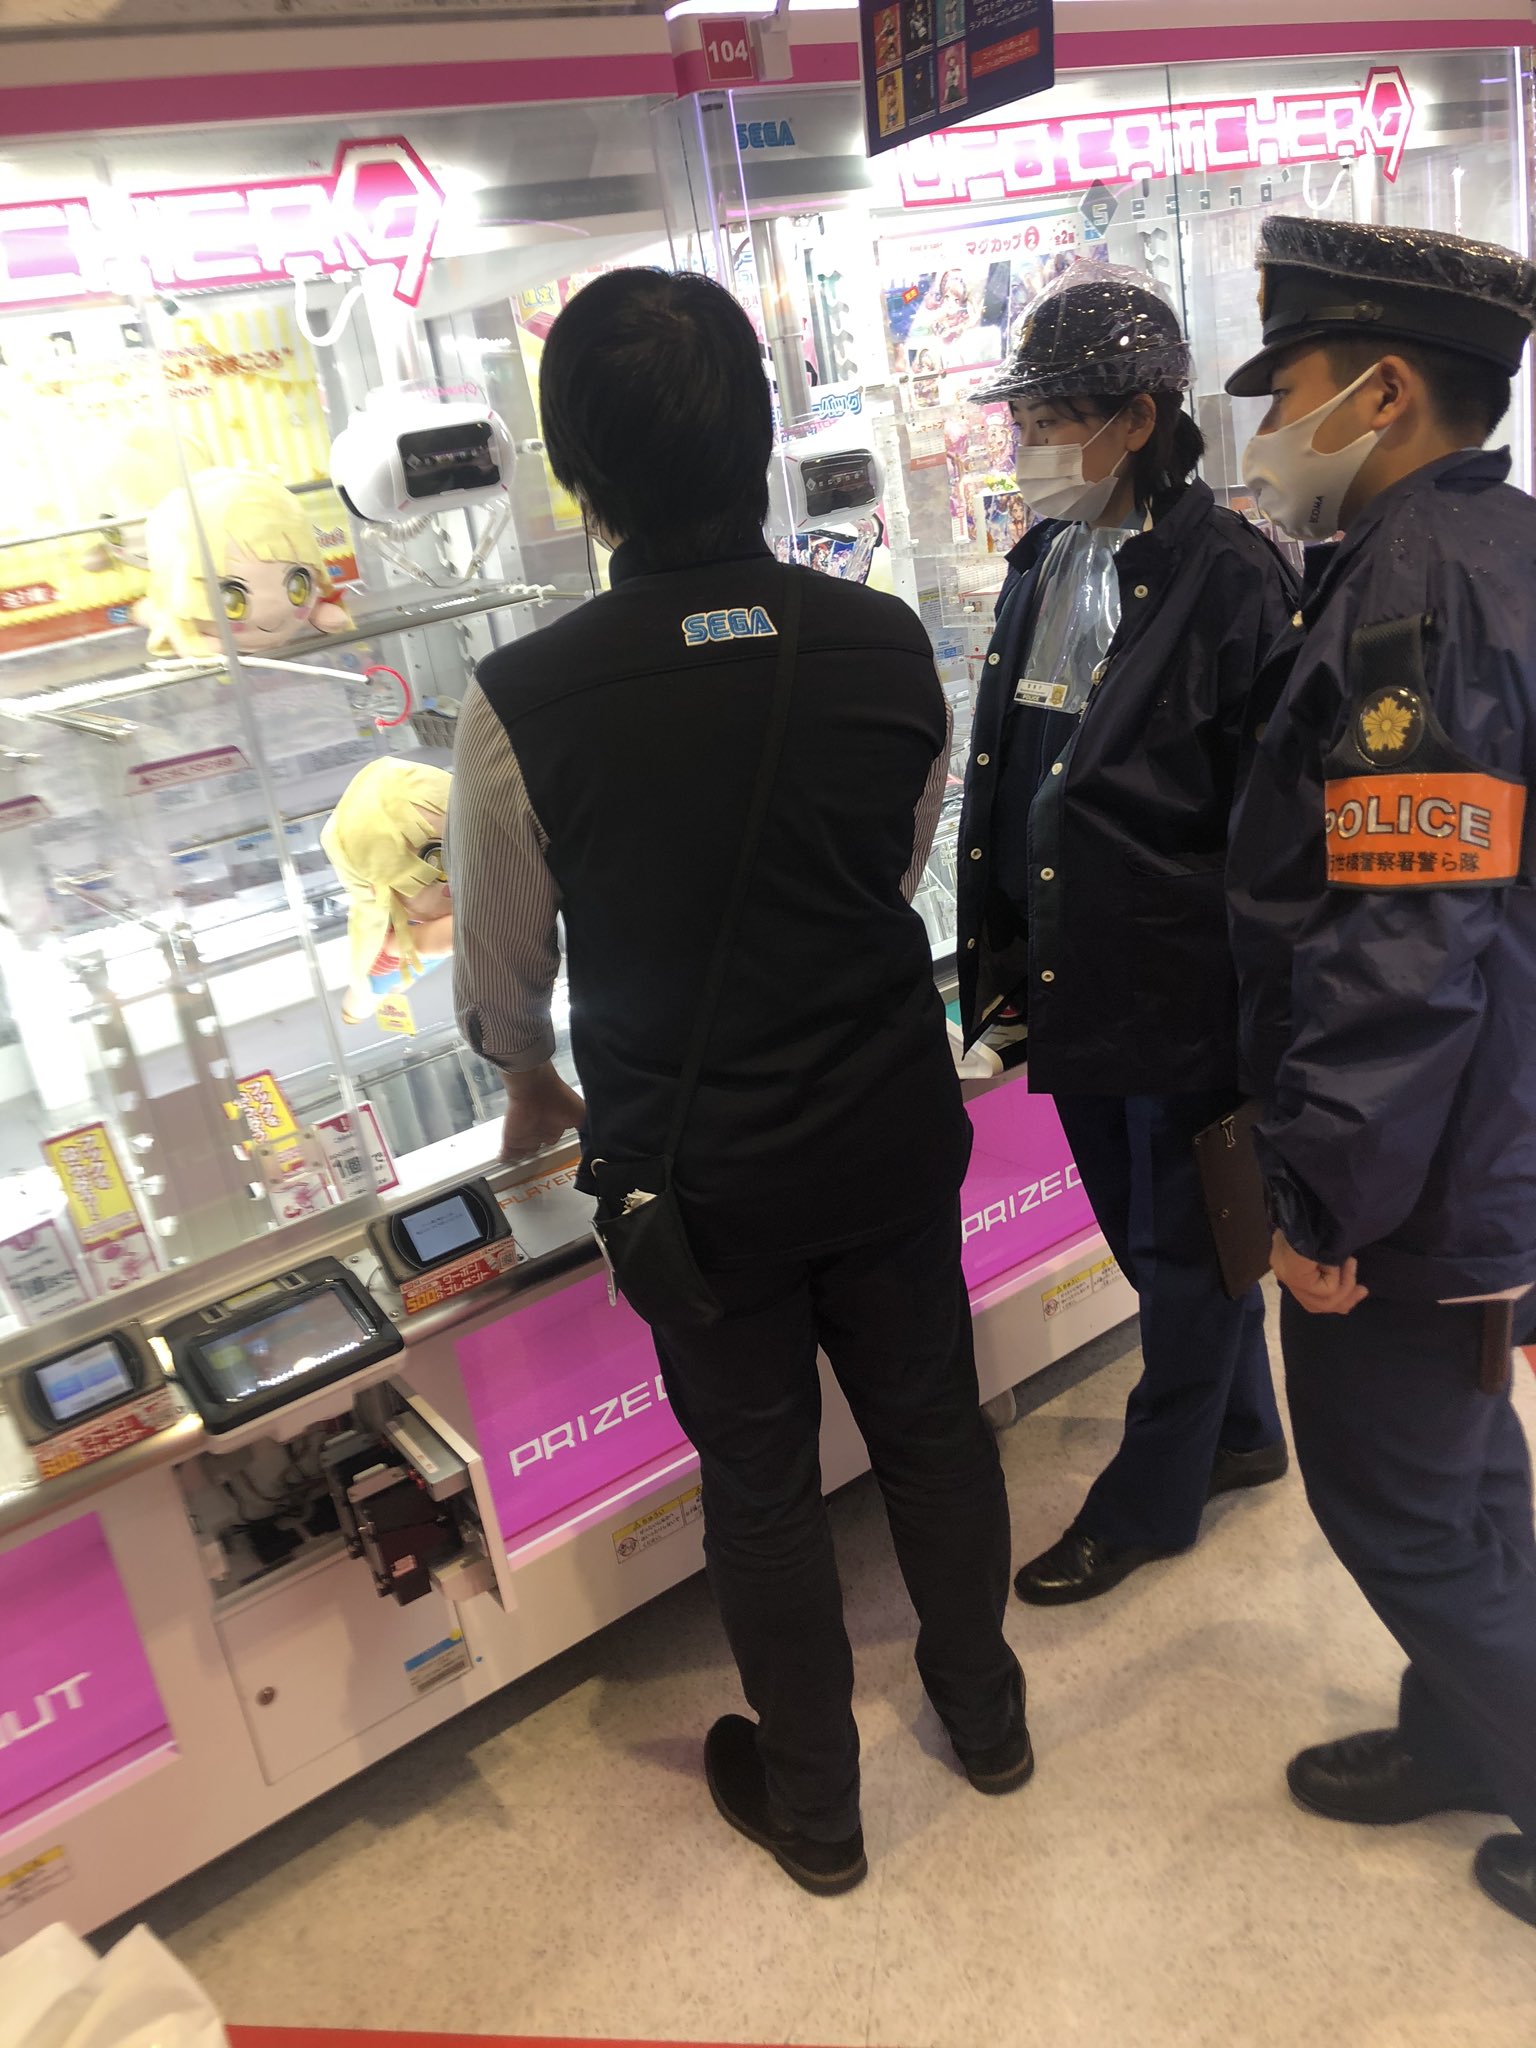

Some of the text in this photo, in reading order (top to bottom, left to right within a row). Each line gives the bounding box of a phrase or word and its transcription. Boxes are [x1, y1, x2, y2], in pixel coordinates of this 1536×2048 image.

[708, 39, 748, 63] 104
[736, 121, 795, 150] SEGA
[1059, 95, 1368, 184] CATCHER
[966, 234, 1021, 255] マグカップ
[682, 606, 778, 646] SEGA
[0, 1670, 93, 1750] UT
